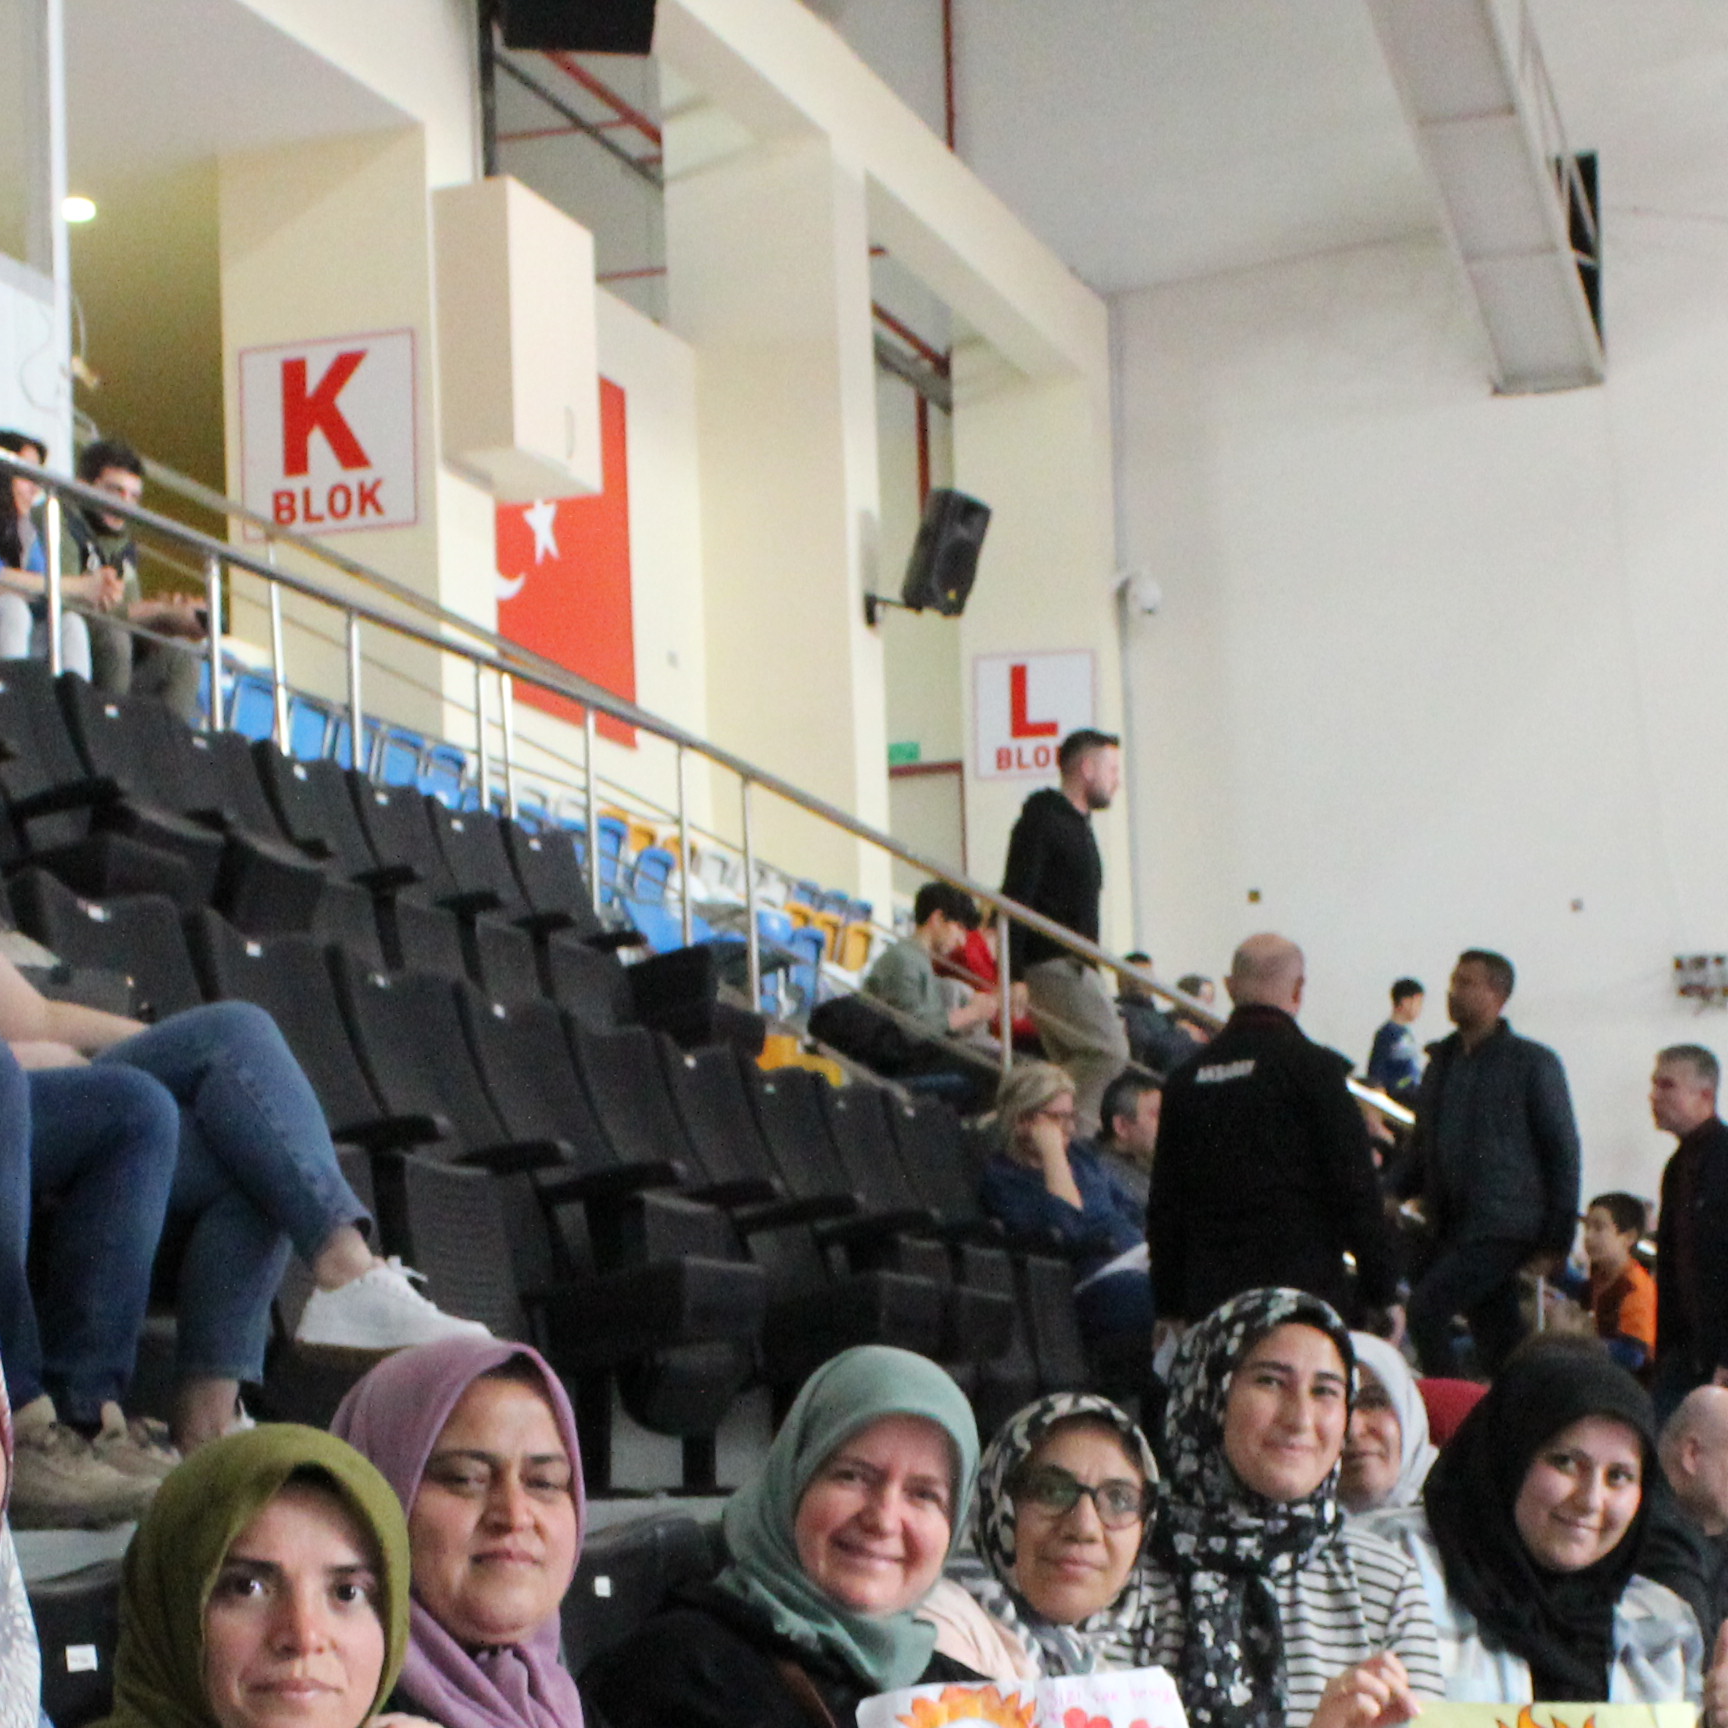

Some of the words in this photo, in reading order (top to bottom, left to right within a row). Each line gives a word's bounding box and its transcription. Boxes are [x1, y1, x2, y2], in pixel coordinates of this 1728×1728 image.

[280, 349, 373, 479] K
[272, 478, 386, 526] BLOK
[1009, 663, 1059, 739] L
[996, 745, 1061, 770] BLO
